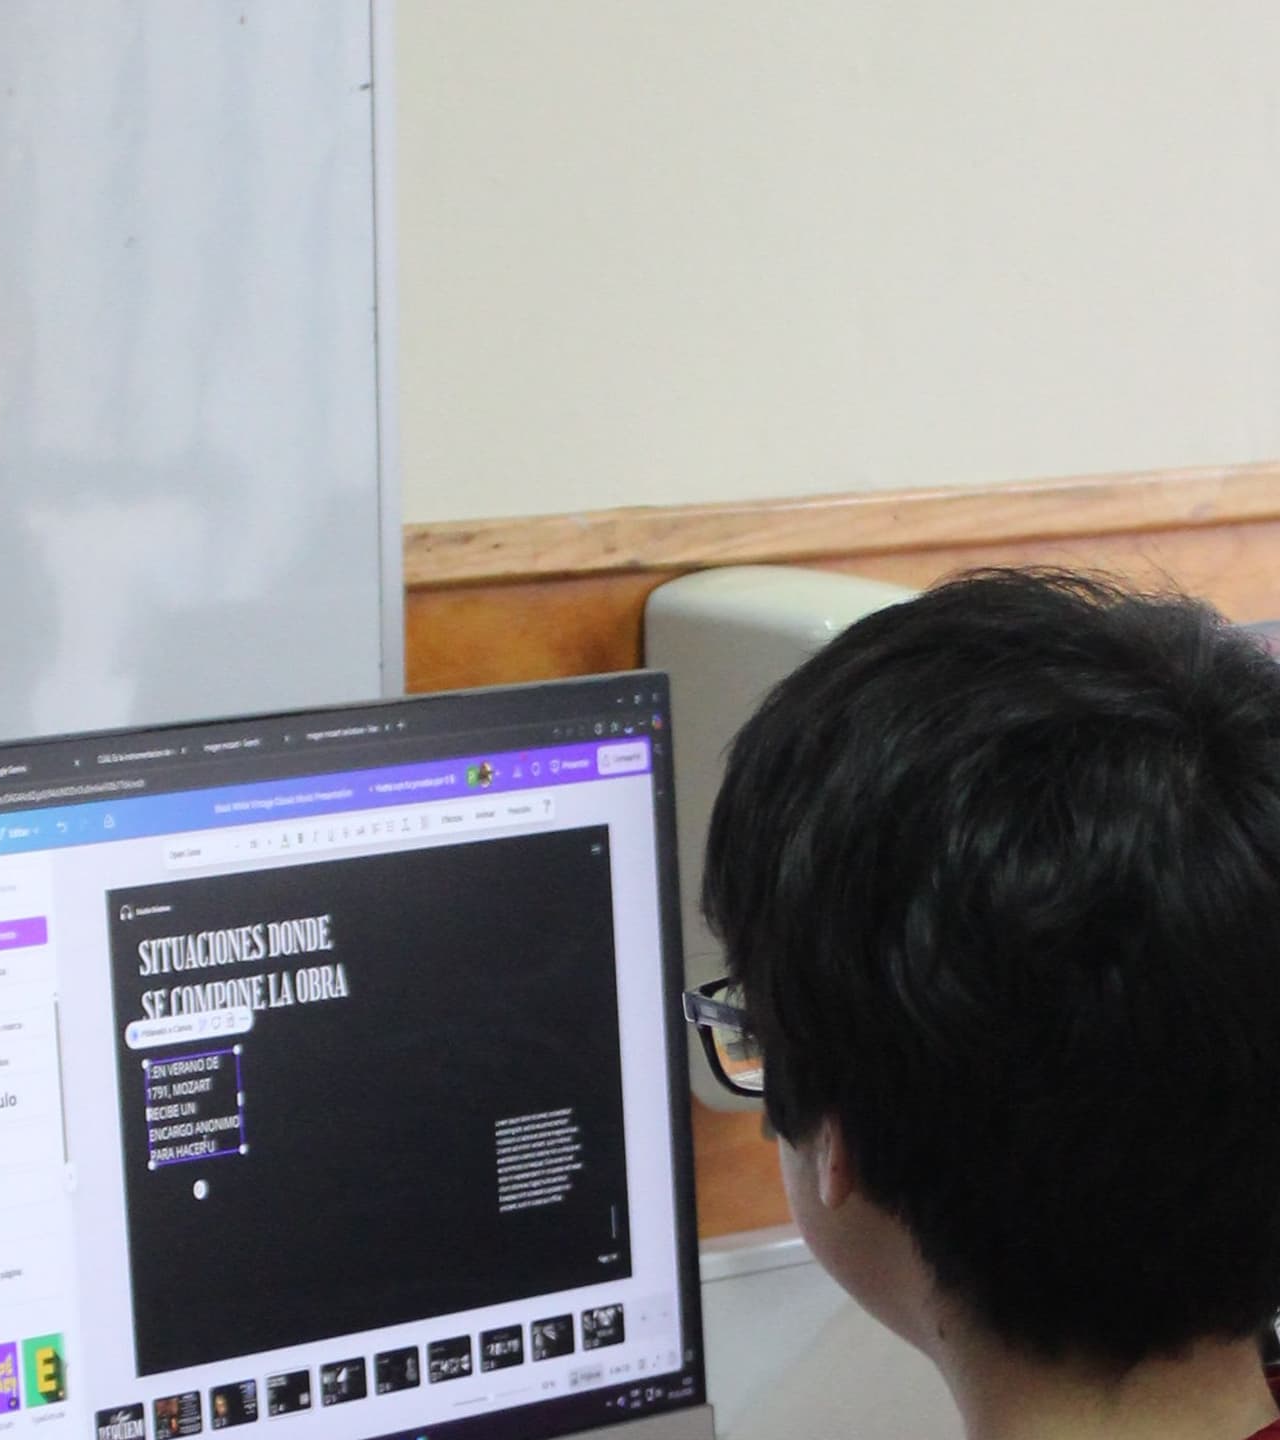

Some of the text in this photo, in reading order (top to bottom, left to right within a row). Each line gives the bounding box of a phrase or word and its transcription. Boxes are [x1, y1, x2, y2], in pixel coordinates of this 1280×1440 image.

[138, 914, 333, 976] SITUACIONES DONDE
[142, 963, 348, 1020] SE COMPONE LA OBRA
[168, 1058, 205, 1077] VERANO
[206, 1055, 219, 1071] DE
[147, 1078, 211, 1100] 1791, MOZART
[147, 1101, 196, 1121] RECIBE UN
[149, 1114, 241, 1142] ENCARGO ANONIMO
[150, 1145, 174, 1160] PARA
[176, 1140, 205, 1158] HACER
[35, 1346, 57, 1394] E
